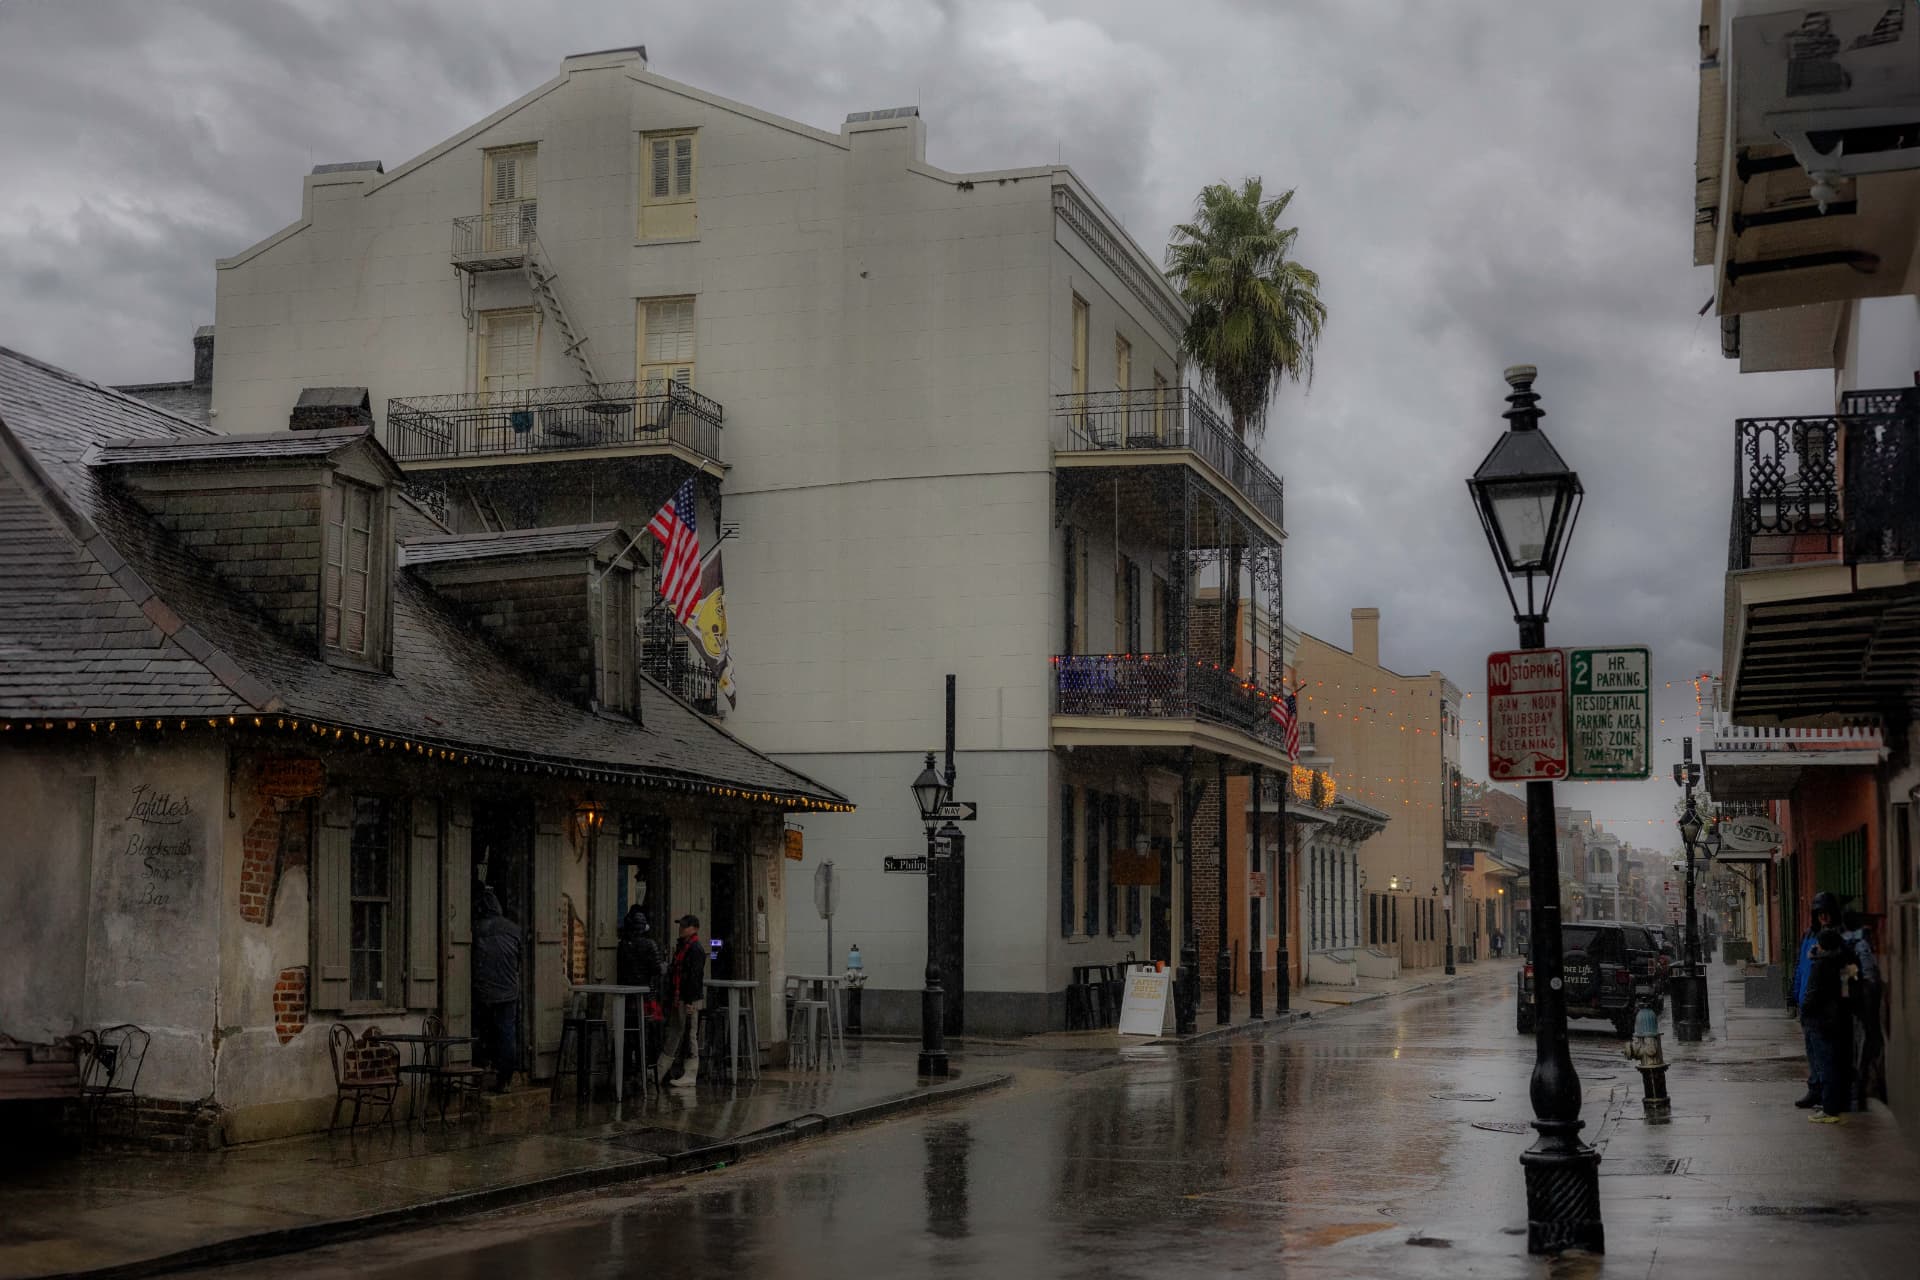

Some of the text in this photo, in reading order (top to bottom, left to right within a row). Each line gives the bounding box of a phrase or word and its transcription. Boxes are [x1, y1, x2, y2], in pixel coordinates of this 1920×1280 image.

[1490, 662, 1561, 687] NO STOPPING
[1575, 661, 1588, 685] 2
[1596, 671, 1640, 687] PARKING
[1532, 696, 1558, 710] NOON
[1576, 696, 1641, 711] RESIDENTIAL
[1501, 712, 1553, 726] THURSDAY
[1576, 714, 1640, 729] PARKING AREA
[1507, 725, 1547, 738] STREET
[1582, 731, 1637, 746] THIS ZONE
[1499, 738, 1556, 751] CLEANING
[944, 807, 960, 815] WAY
[1722, 823, 1783, 843] POSTAL
[124, 833, 192, 856] Blacksmith
[885, 860, 927, 871] St. Philip
[139, 883, 170, 906] Bar
